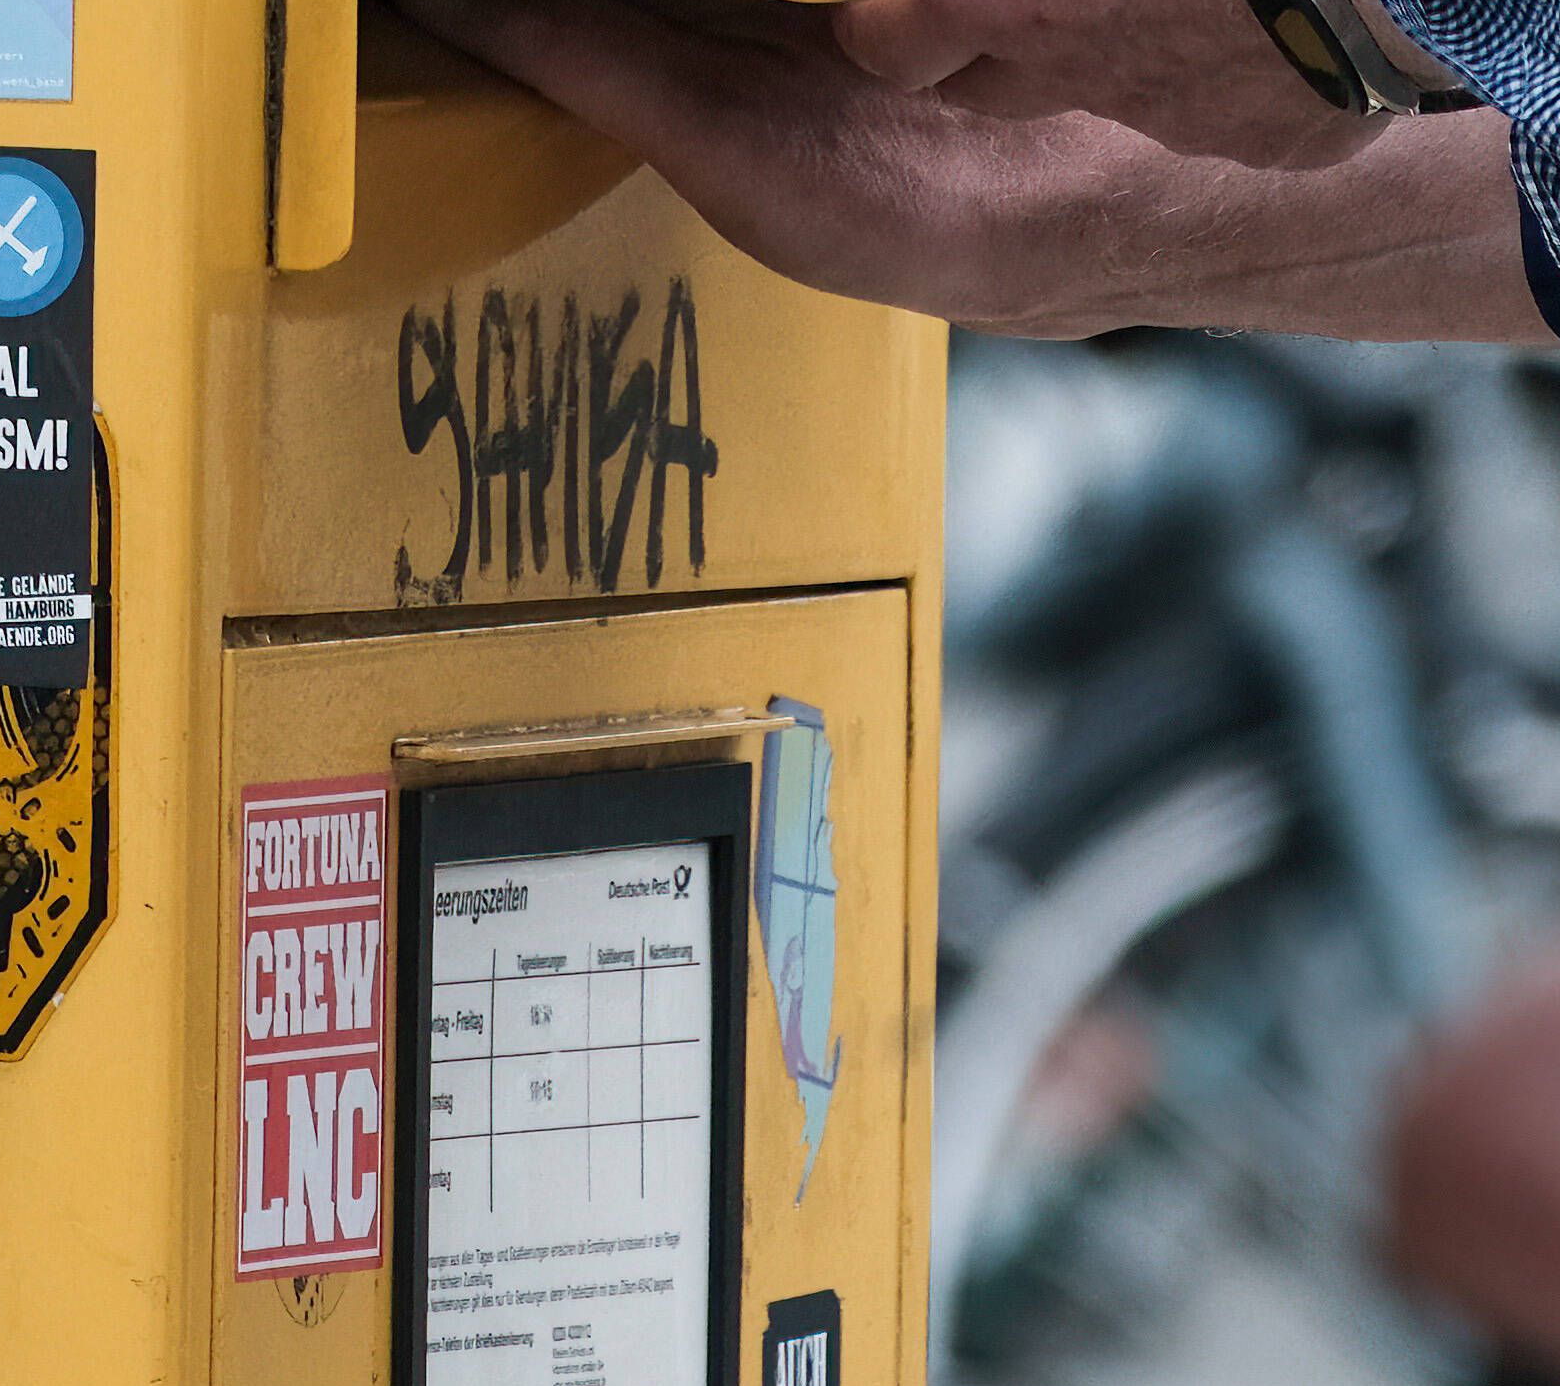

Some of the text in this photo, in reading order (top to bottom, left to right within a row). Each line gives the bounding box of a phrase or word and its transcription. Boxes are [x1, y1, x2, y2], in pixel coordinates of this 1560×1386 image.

[5, 599, 75, 621] HAMBURG
[12, 573, 76, 596] GELÄNDE
[246, 811, 380, 893] FORTUNA
[433, 878, 528, 925] eerungszeiten
[245, 919, 379, 1041] CREW
[243, 1067, 378, 1253] LNC
